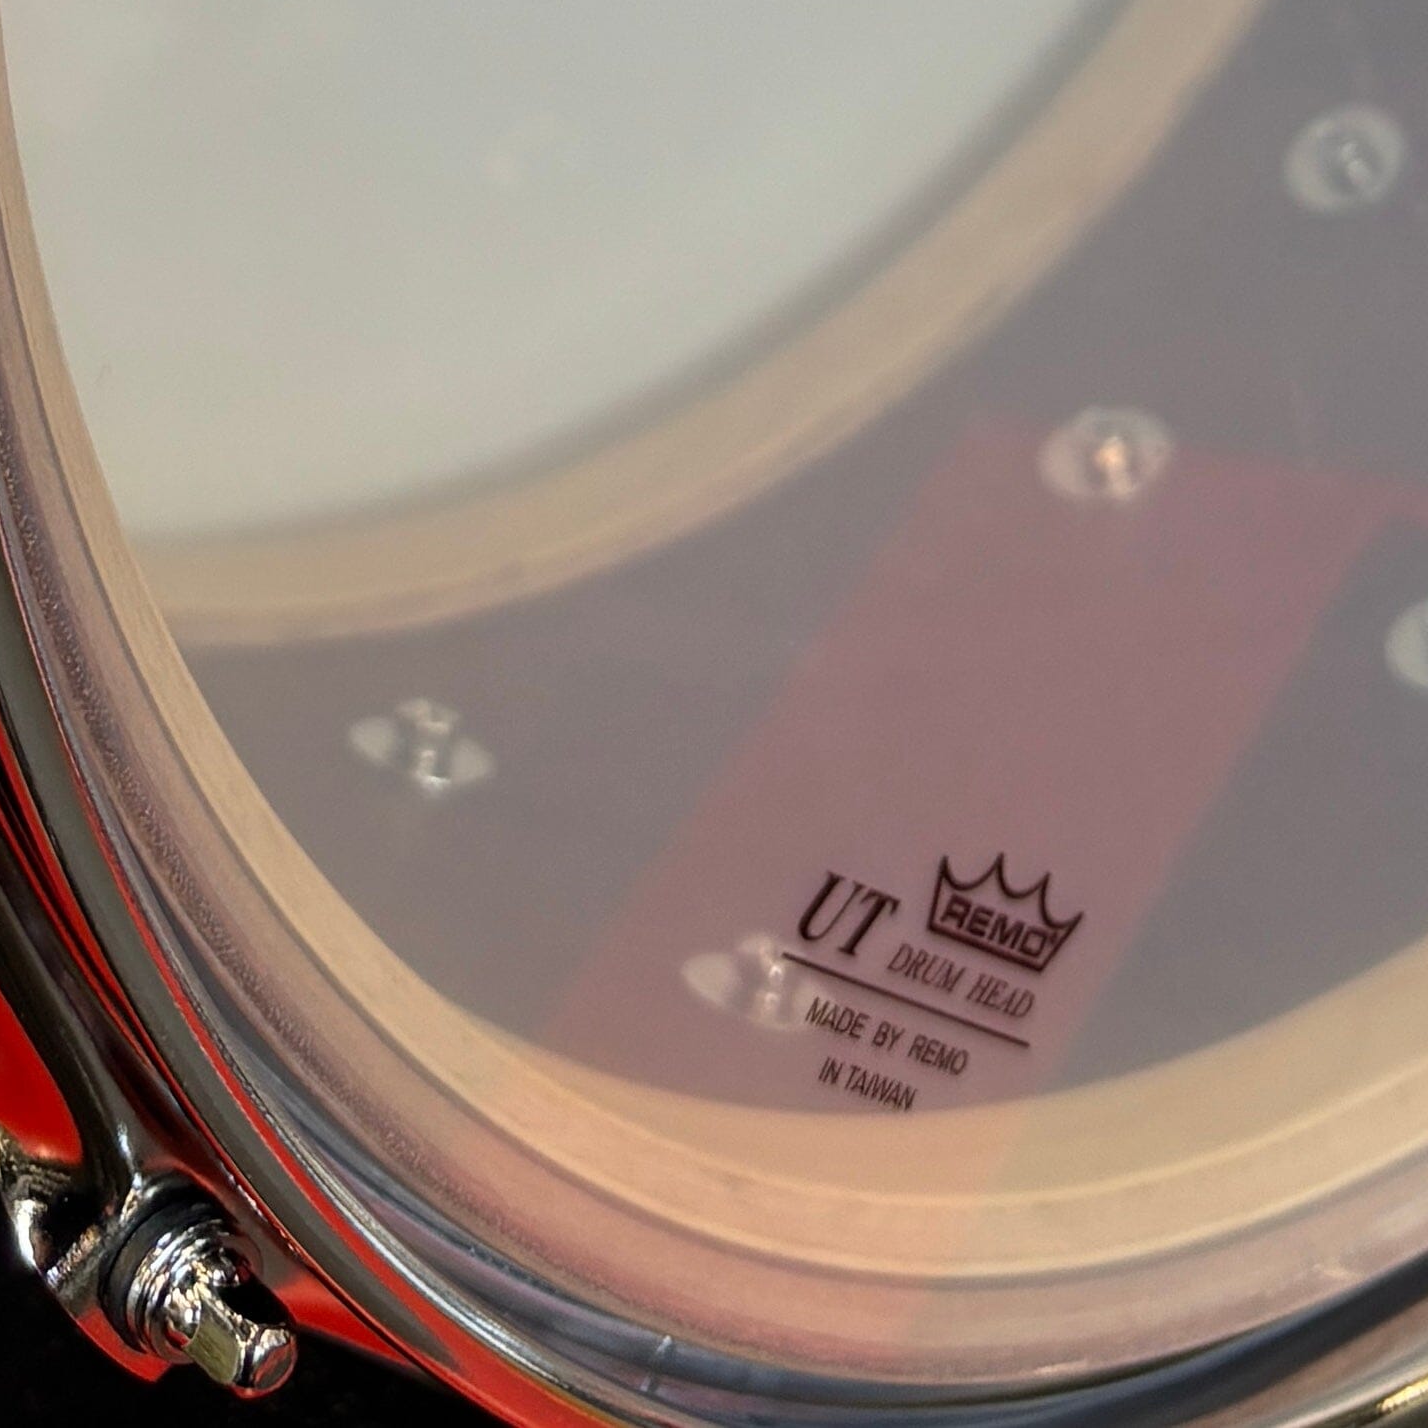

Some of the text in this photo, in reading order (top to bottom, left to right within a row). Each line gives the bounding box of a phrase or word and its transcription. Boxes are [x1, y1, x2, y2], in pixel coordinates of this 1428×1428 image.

[798, 870, 901, 957] UT
[939, 893, 1049, 959] REMO
[886, 942, 1036, 1019] DRUM HEAD
[804, 996, 970, 1077] MADE BY REMO
[818, 1056, 918, 1112] IN TAIWAN
